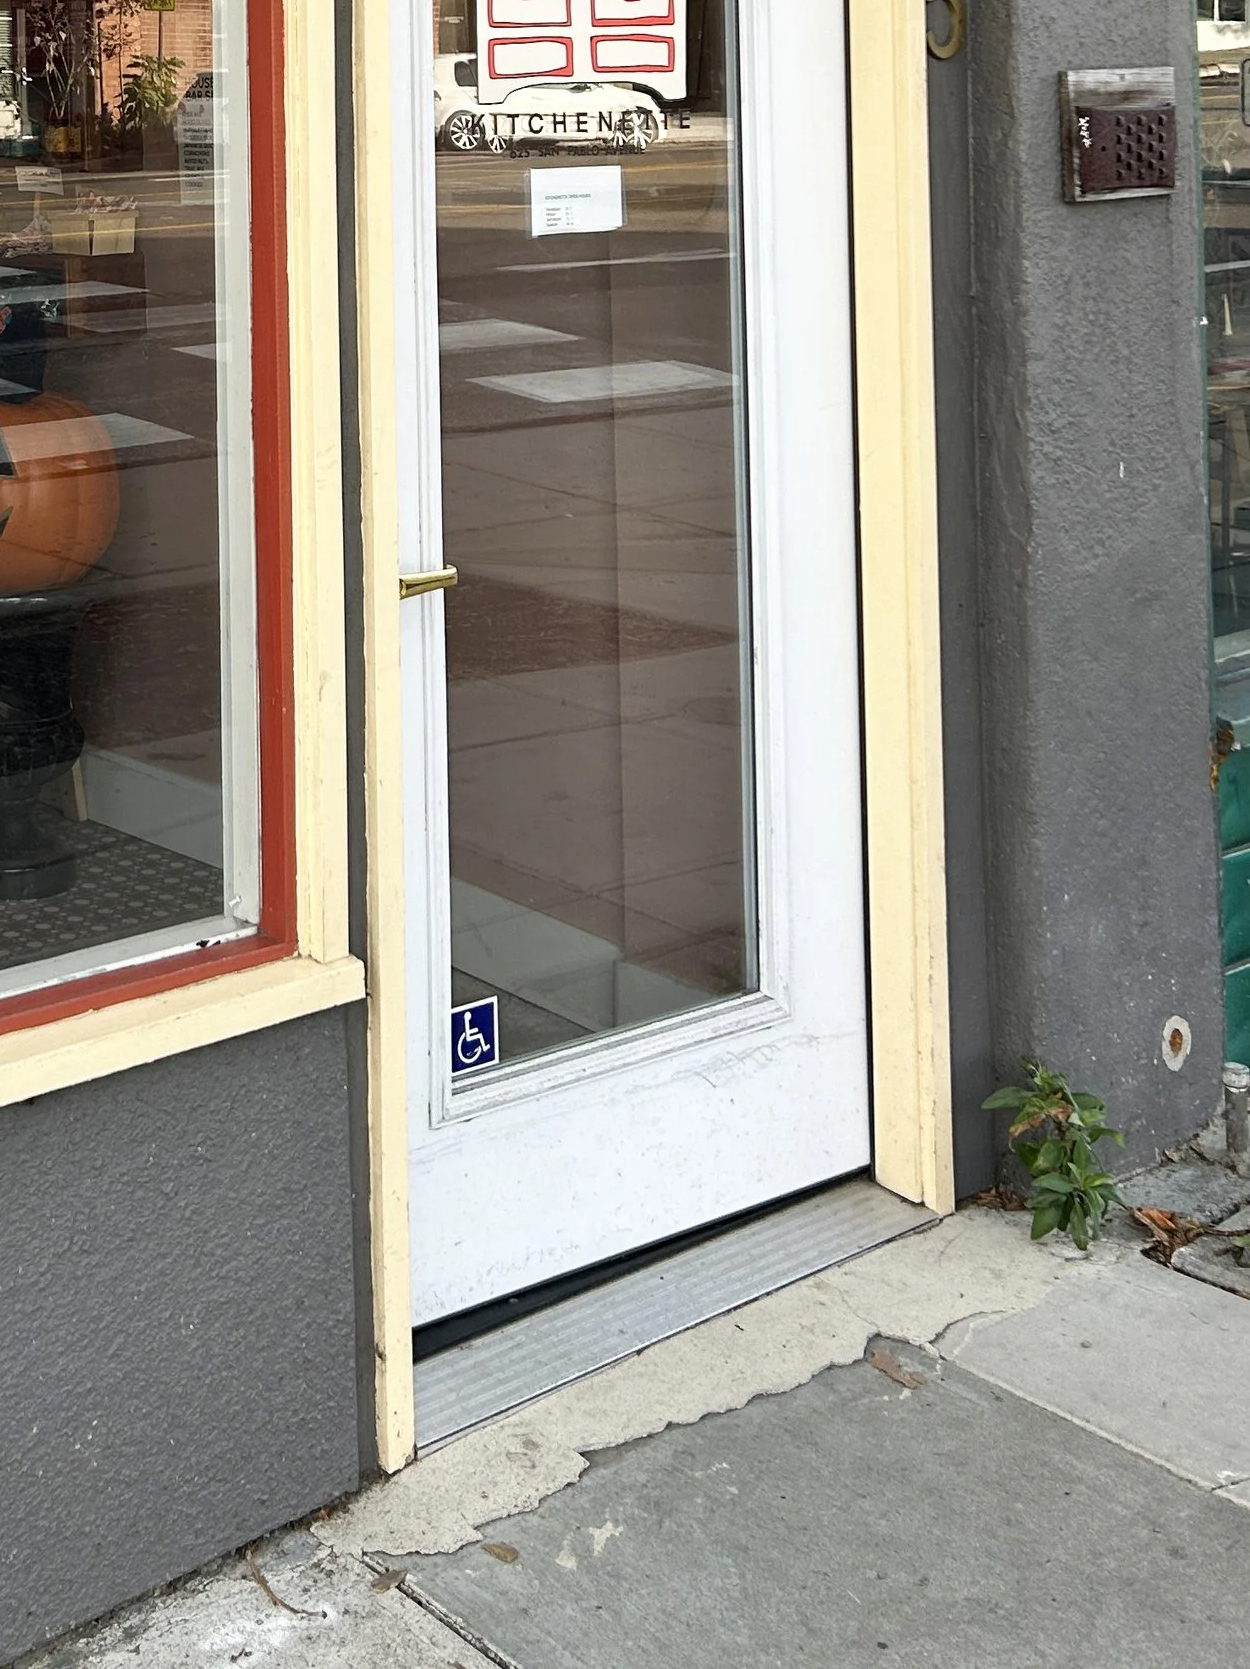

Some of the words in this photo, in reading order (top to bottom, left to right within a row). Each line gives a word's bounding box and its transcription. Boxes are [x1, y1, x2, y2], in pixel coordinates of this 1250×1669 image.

[469, 107, 691, 136] KITCHENETTE
[538, 146, 560, 158] SAN
[567, 144, 599, 156] PABLO
